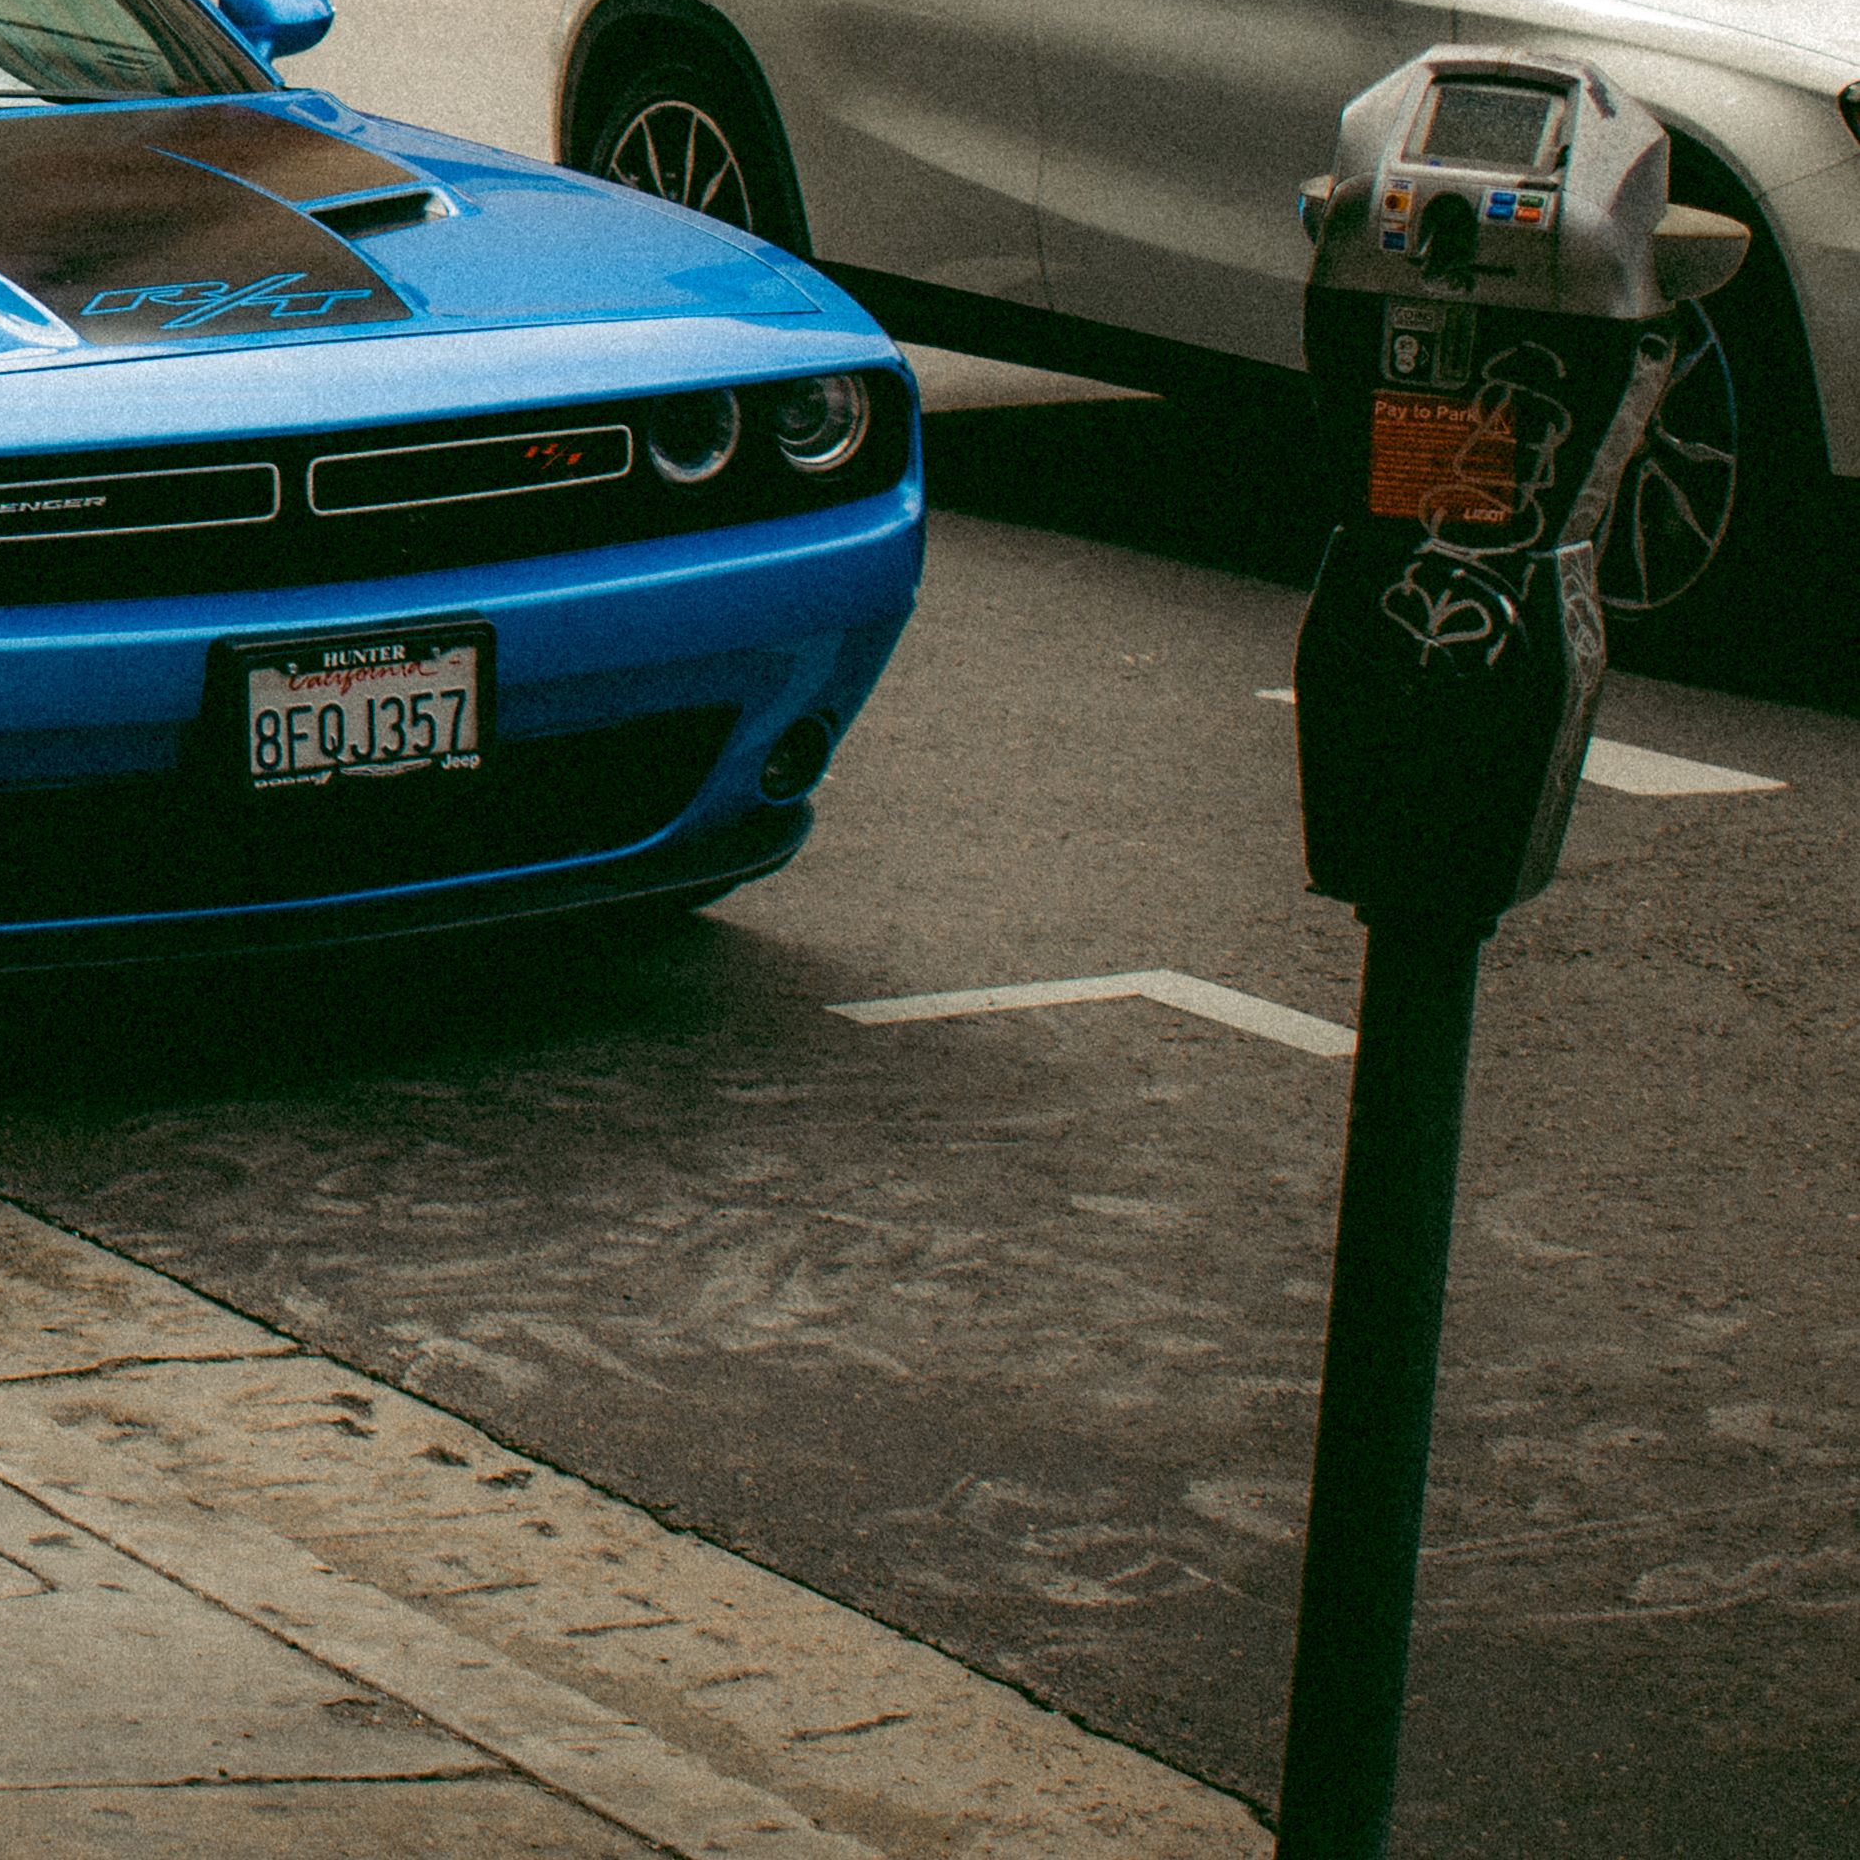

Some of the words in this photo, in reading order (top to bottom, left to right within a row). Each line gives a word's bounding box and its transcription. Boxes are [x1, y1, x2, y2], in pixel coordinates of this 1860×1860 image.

[80, 271, 374, 331] R/T
[1375, 401, 1408, 421] Pay
[1412, 405, 1432, 420] to
[1436, 405, 1479, 423] Park
[322, 644, 407, 669] HUNTER
[254, 688, 468, 772] 8FQJ357
[440, 751, 481, 772] Jeep
